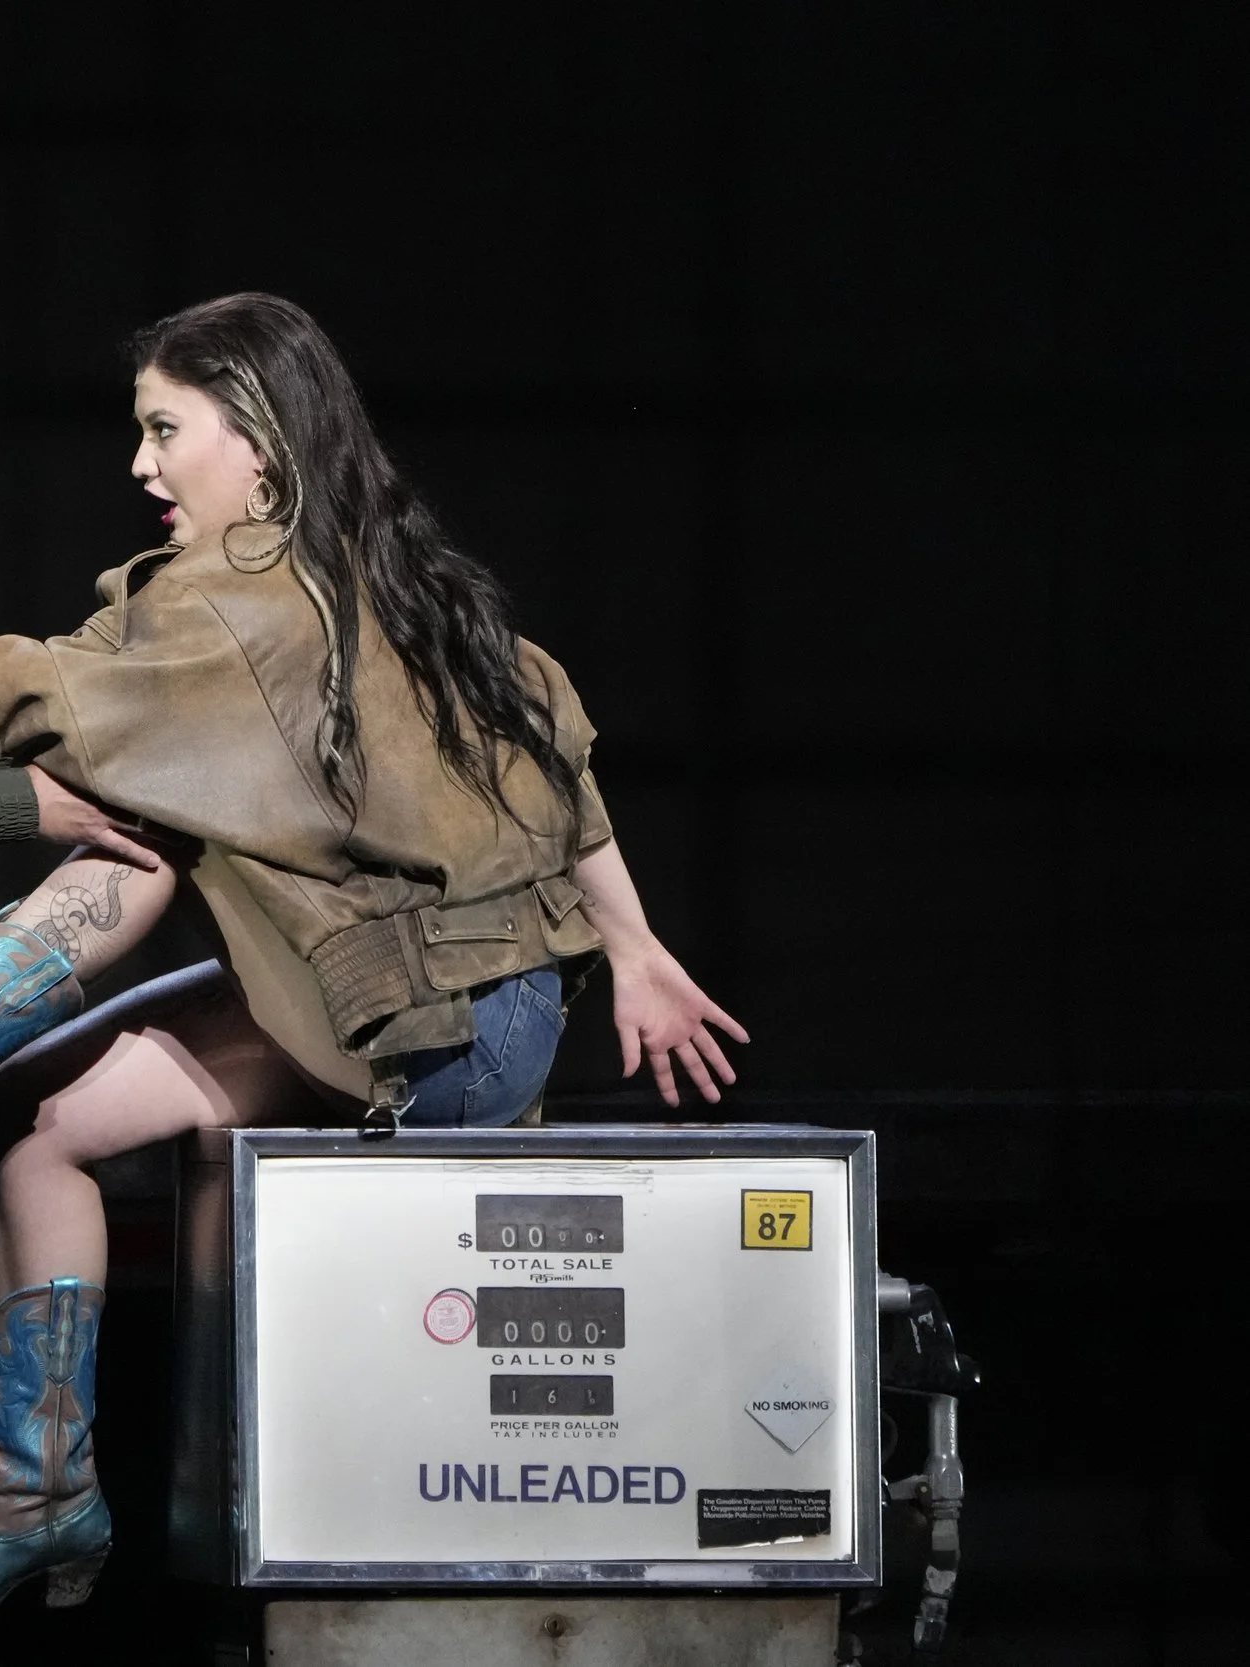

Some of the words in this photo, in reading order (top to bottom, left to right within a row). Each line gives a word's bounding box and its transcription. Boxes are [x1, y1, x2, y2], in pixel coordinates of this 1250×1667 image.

[758, 1212, 796, 1240] 87
[457, 1232, 473, 1250] $
[489, 1259, 555, 1270] TOTAL
[563, 1259, 613, 1270] SALE
[492, 1354, 616, 1365] GALLONS
[752, 1401, 770, 1411] NO
[773, 1401, 829, 1411] SMOKING
[490, 1422, 529, 1430] PRICE
[534, 1422, 560, 1430] PER
[565, 1422, 619, 1430] GALLON
[419, 1463, 686, 1504] UNLEADED
